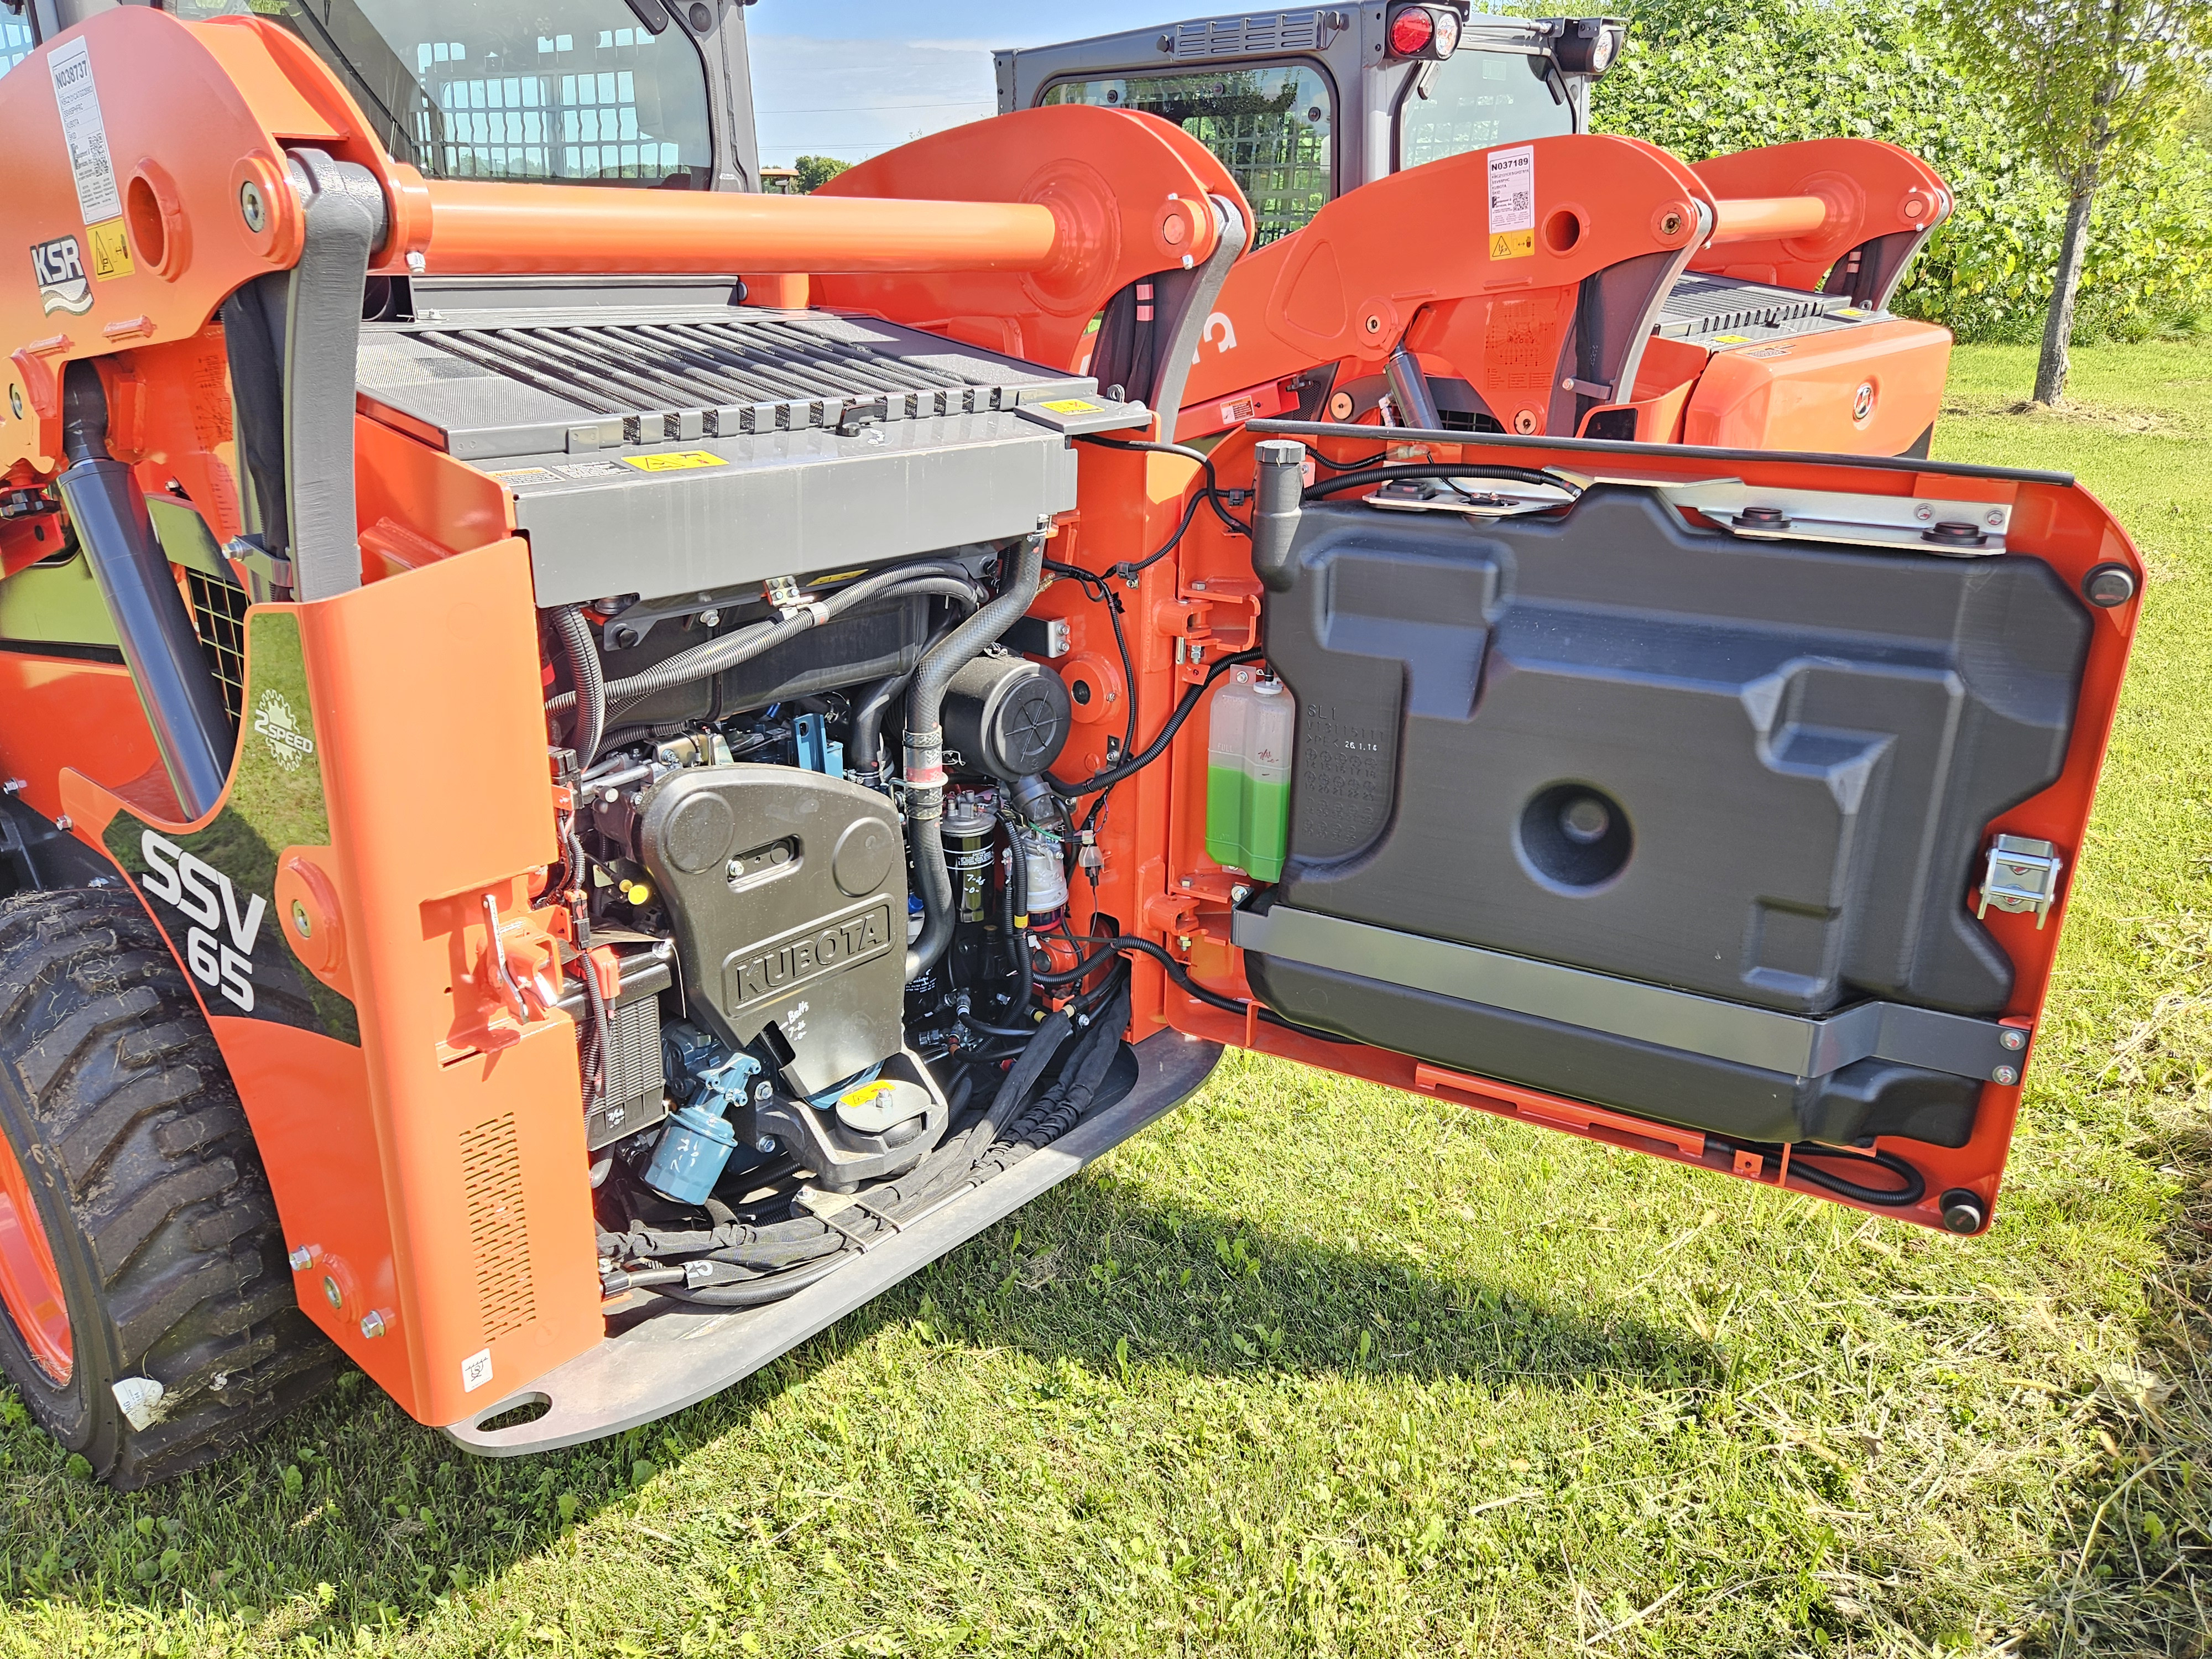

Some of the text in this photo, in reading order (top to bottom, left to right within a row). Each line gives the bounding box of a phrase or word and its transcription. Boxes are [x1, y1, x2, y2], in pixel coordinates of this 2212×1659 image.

[55, 60, 88, 90] N038737
[1491, 158, 1528, 171] N037189
[31, 239, 84, 286] KSR
[1217, 743, 1234, 753] FULL
[142, 830, 267, 956] SSV
[187, 926, 254, 1012] 65
[737, 914, 882, 1001] KUBOTA
